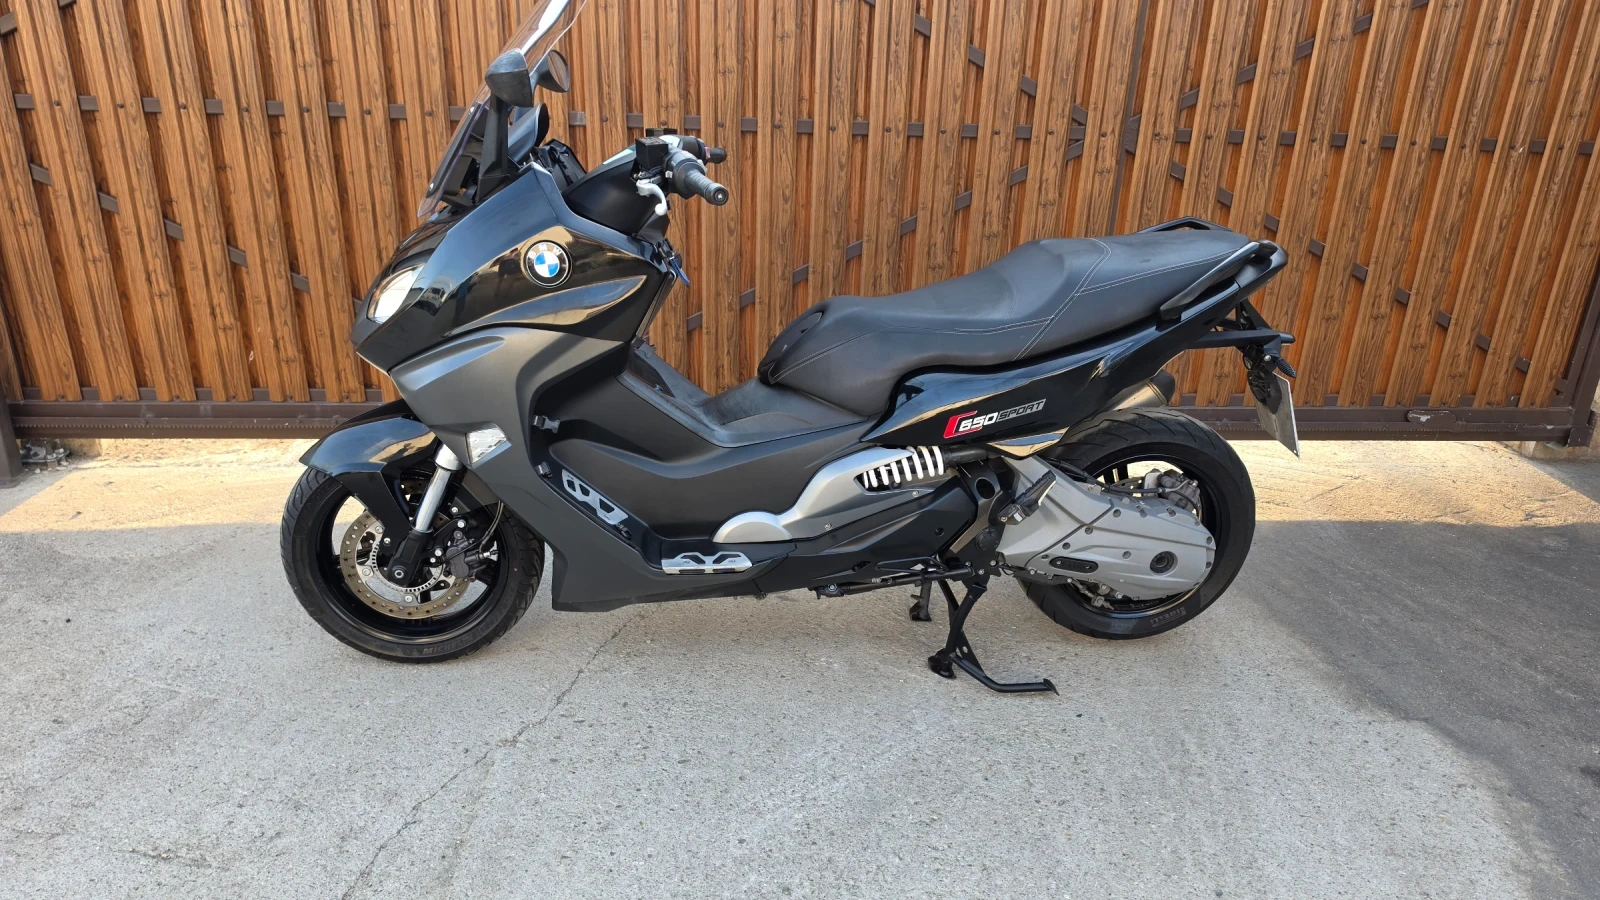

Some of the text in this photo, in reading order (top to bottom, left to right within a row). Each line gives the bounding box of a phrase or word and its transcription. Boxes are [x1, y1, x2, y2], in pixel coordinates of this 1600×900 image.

[527, 243, 563, 260] BMW
[997, 399, 1047, 422] SPORT
[422, 633, 474, 655] MICHELIN
